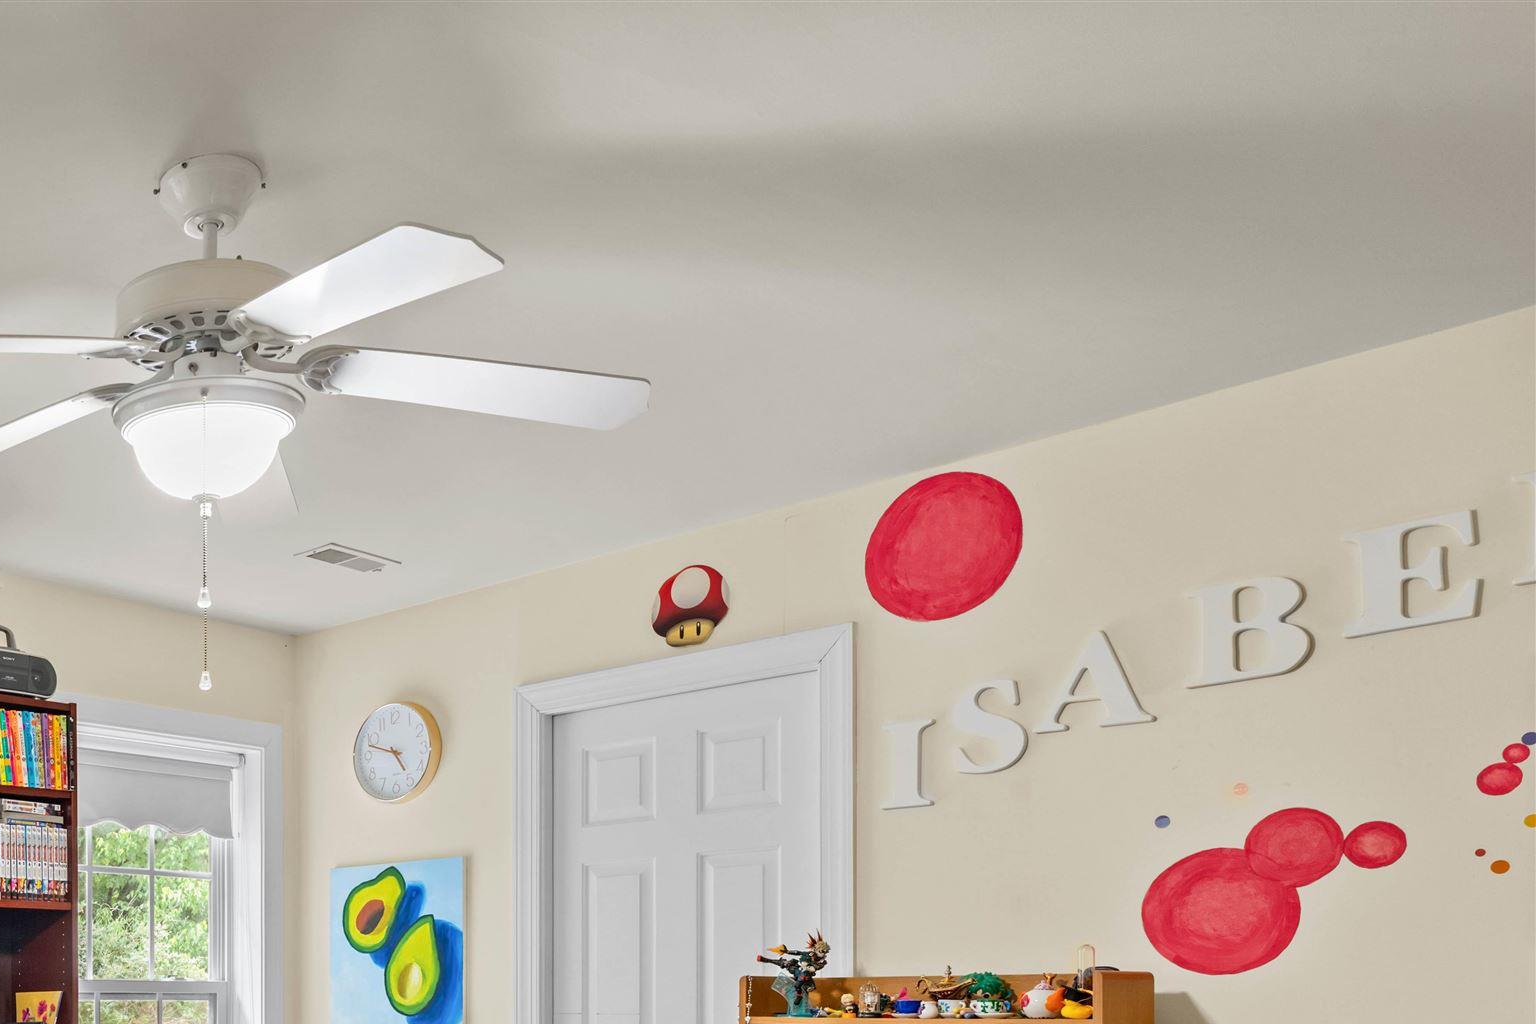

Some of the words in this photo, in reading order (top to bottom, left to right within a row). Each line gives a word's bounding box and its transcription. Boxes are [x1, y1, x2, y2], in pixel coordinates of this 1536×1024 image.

[378, 717, 386, 732] 11
[390, 710, 400, 725] 12
[416, 724, 424, 738] 2
[419, 741, 428, 755] 3
[416, 759, 424, 772] 4
[368, 767, 376, 781] 8
[406, 773, 414, 788] 5
[379, 777, 386, 792] 7
[392, 780, 400, 794] 6
